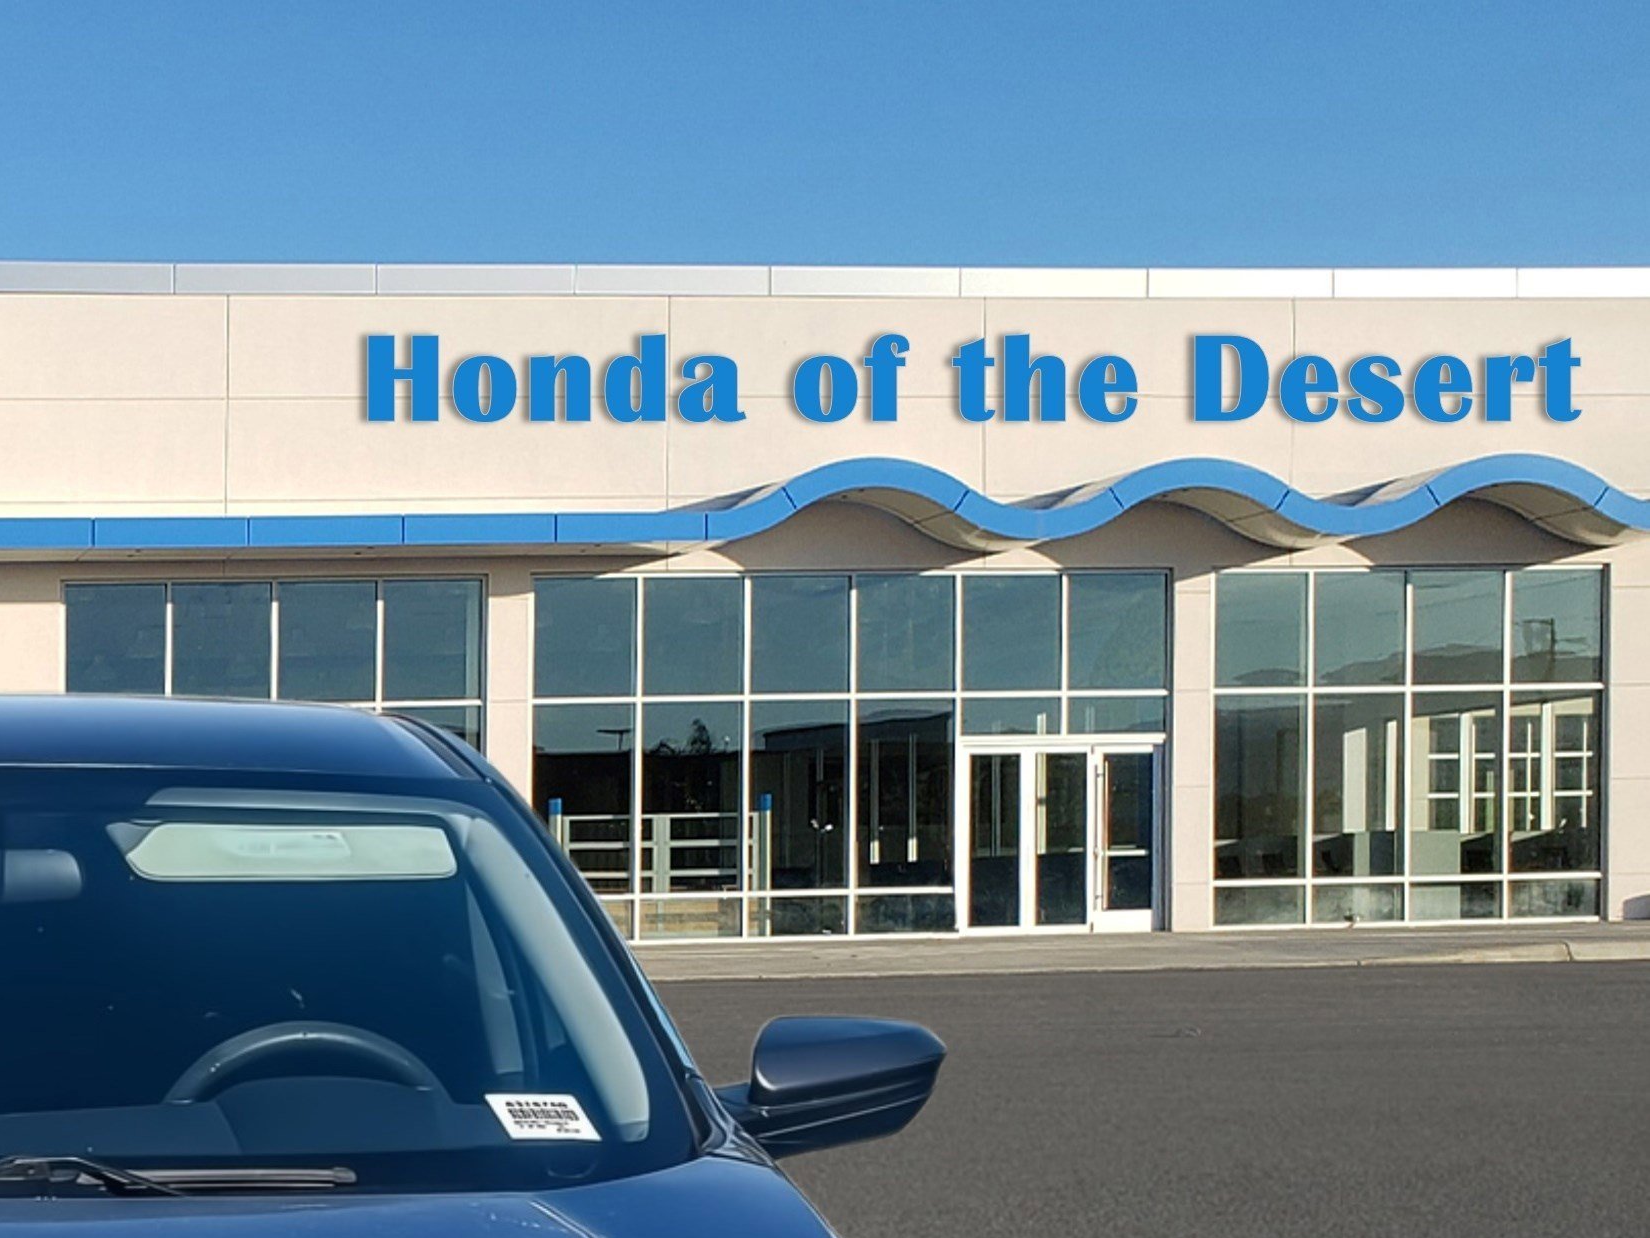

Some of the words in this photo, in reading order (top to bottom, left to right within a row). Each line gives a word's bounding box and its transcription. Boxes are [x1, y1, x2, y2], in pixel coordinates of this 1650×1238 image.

[365, 333, 747, 424] Honda
[792, 333, 912, 424] of
[951, 333, 1139, 424] the
[1193, 333, 1582, 424] Desert
